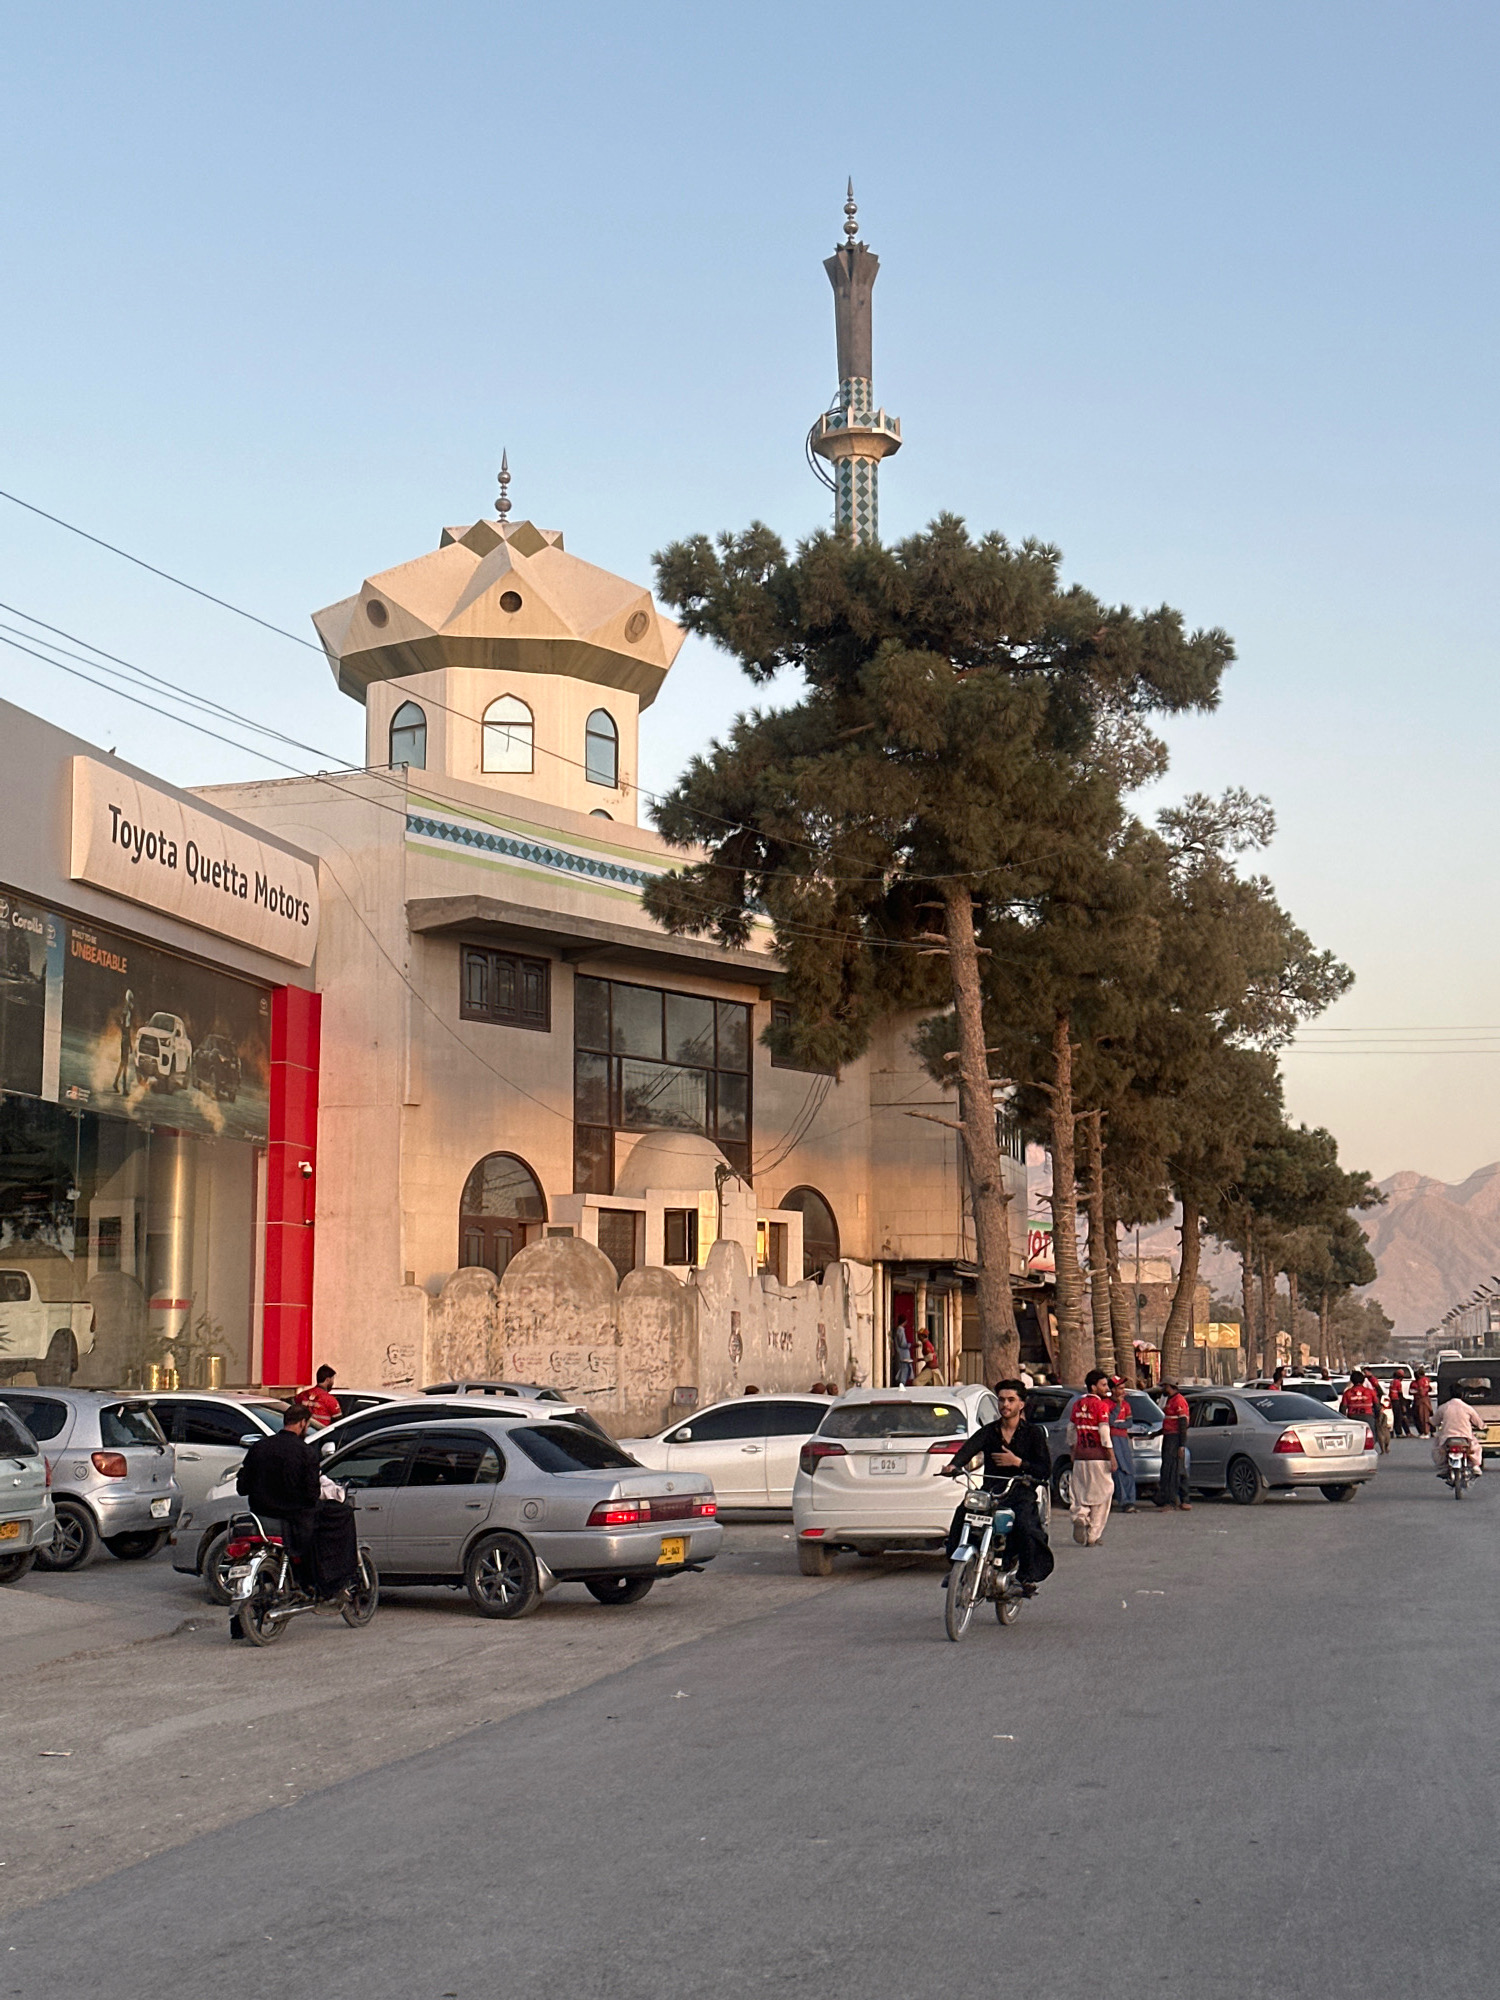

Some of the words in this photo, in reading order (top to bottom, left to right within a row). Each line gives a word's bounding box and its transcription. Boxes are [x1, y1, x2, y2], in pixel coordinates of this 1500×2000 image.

[109, 803, 177, 870] Toyota
[185, 840, 248, 900] Quetta
[254, 871, 310, 927] Motors
[12, 911, 43, 935] Corolla
[71, 940, 128, 974] UNBEATABLE
